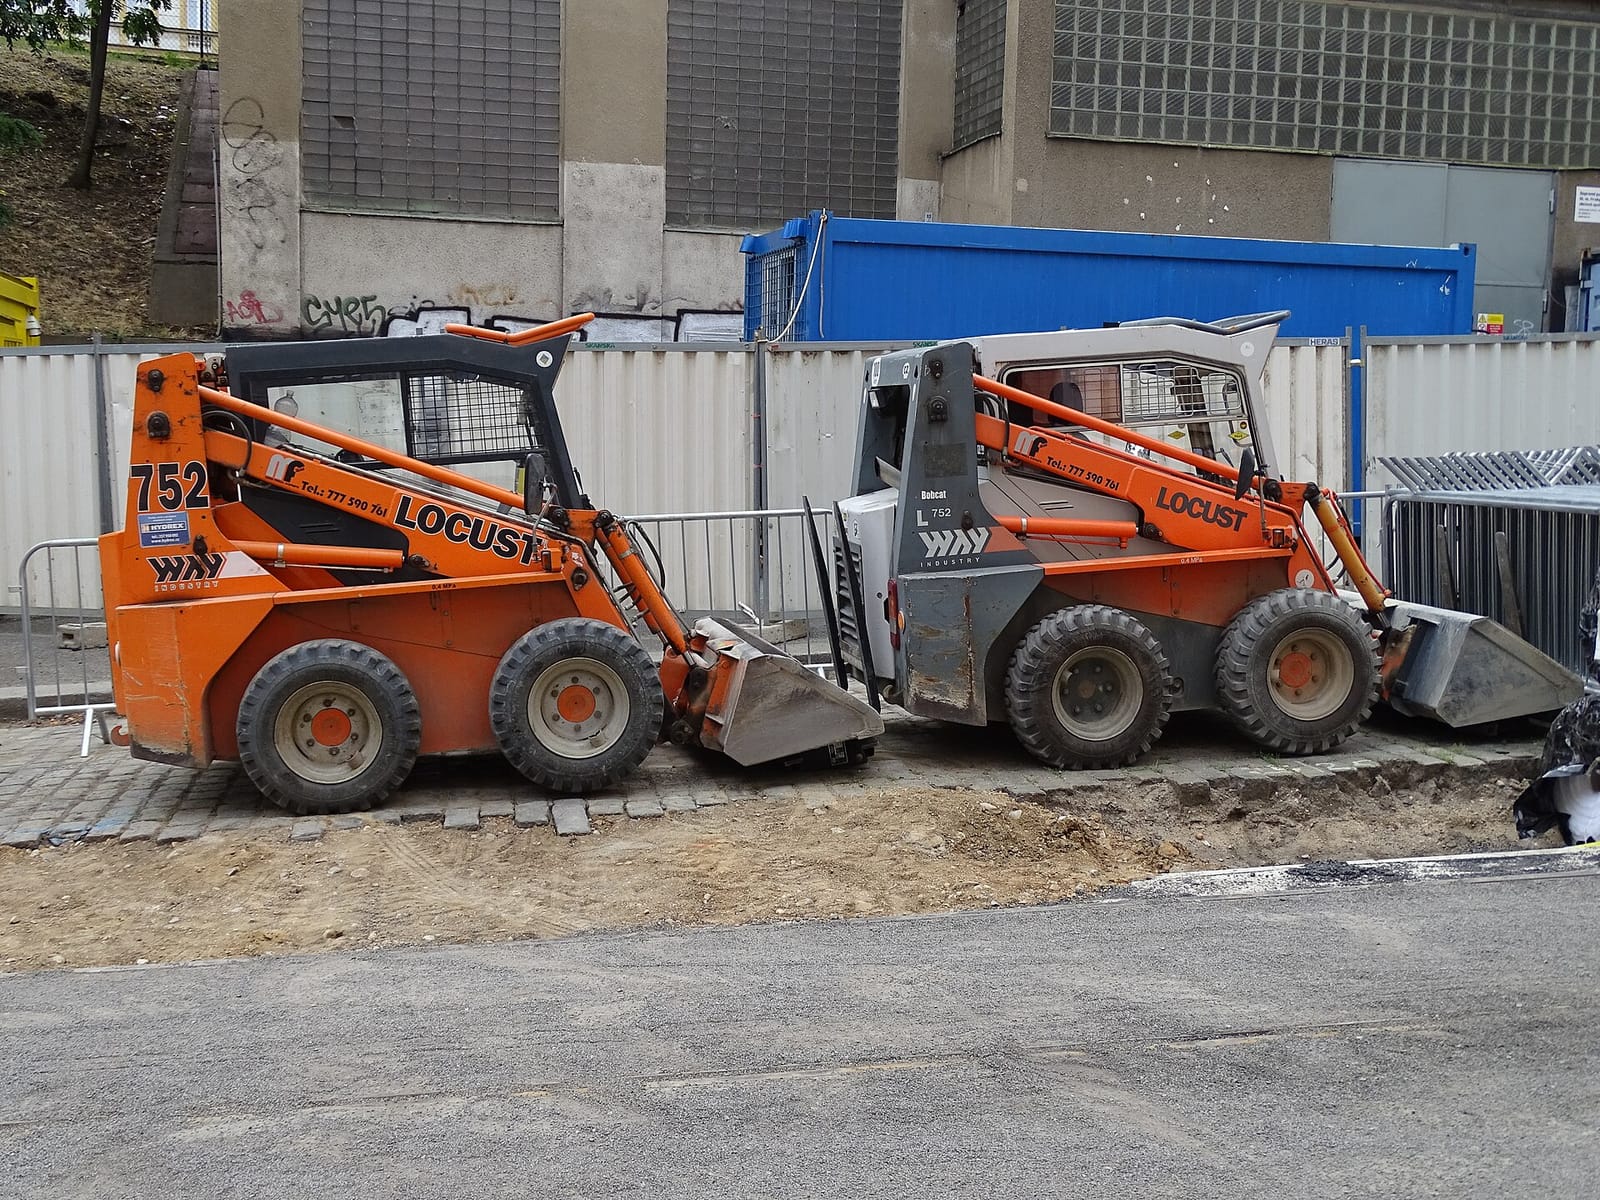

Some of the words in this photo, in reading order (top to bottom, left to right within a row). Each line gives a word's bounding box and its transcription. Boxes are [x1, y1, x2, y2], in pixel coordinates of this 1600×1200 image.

[1310, 338, 1339, 346] HERAS
[129, 461, 210, 512] 752
[1046, 456, 1066, 471] Tel.:
[1069, 464, 1085, 478] 777
[1085, 472, 1103, 485] 590
[1104, 478, 1120, 491] 761
[301, 481, 324, 496] Tel.:
[327, 489, 346, 503] 777
[348, 497, 368, 511] 590
[370, 504, 388, 517] 761
[921, 490, 947, 500] Bobcat
[1156, 486, 1248, 532] LOCUST
[393, 494, 543, 566] LOCUST
[916, 509, 929, 527] L
[931, 508, 951, 517] 752
[918, 526, 989, 558] WAY
[146, 552, 227, 584] WAY
[920, 557, 980, 567] INDUSTRY
[154, 581, 218, 592] INDUSTRY
